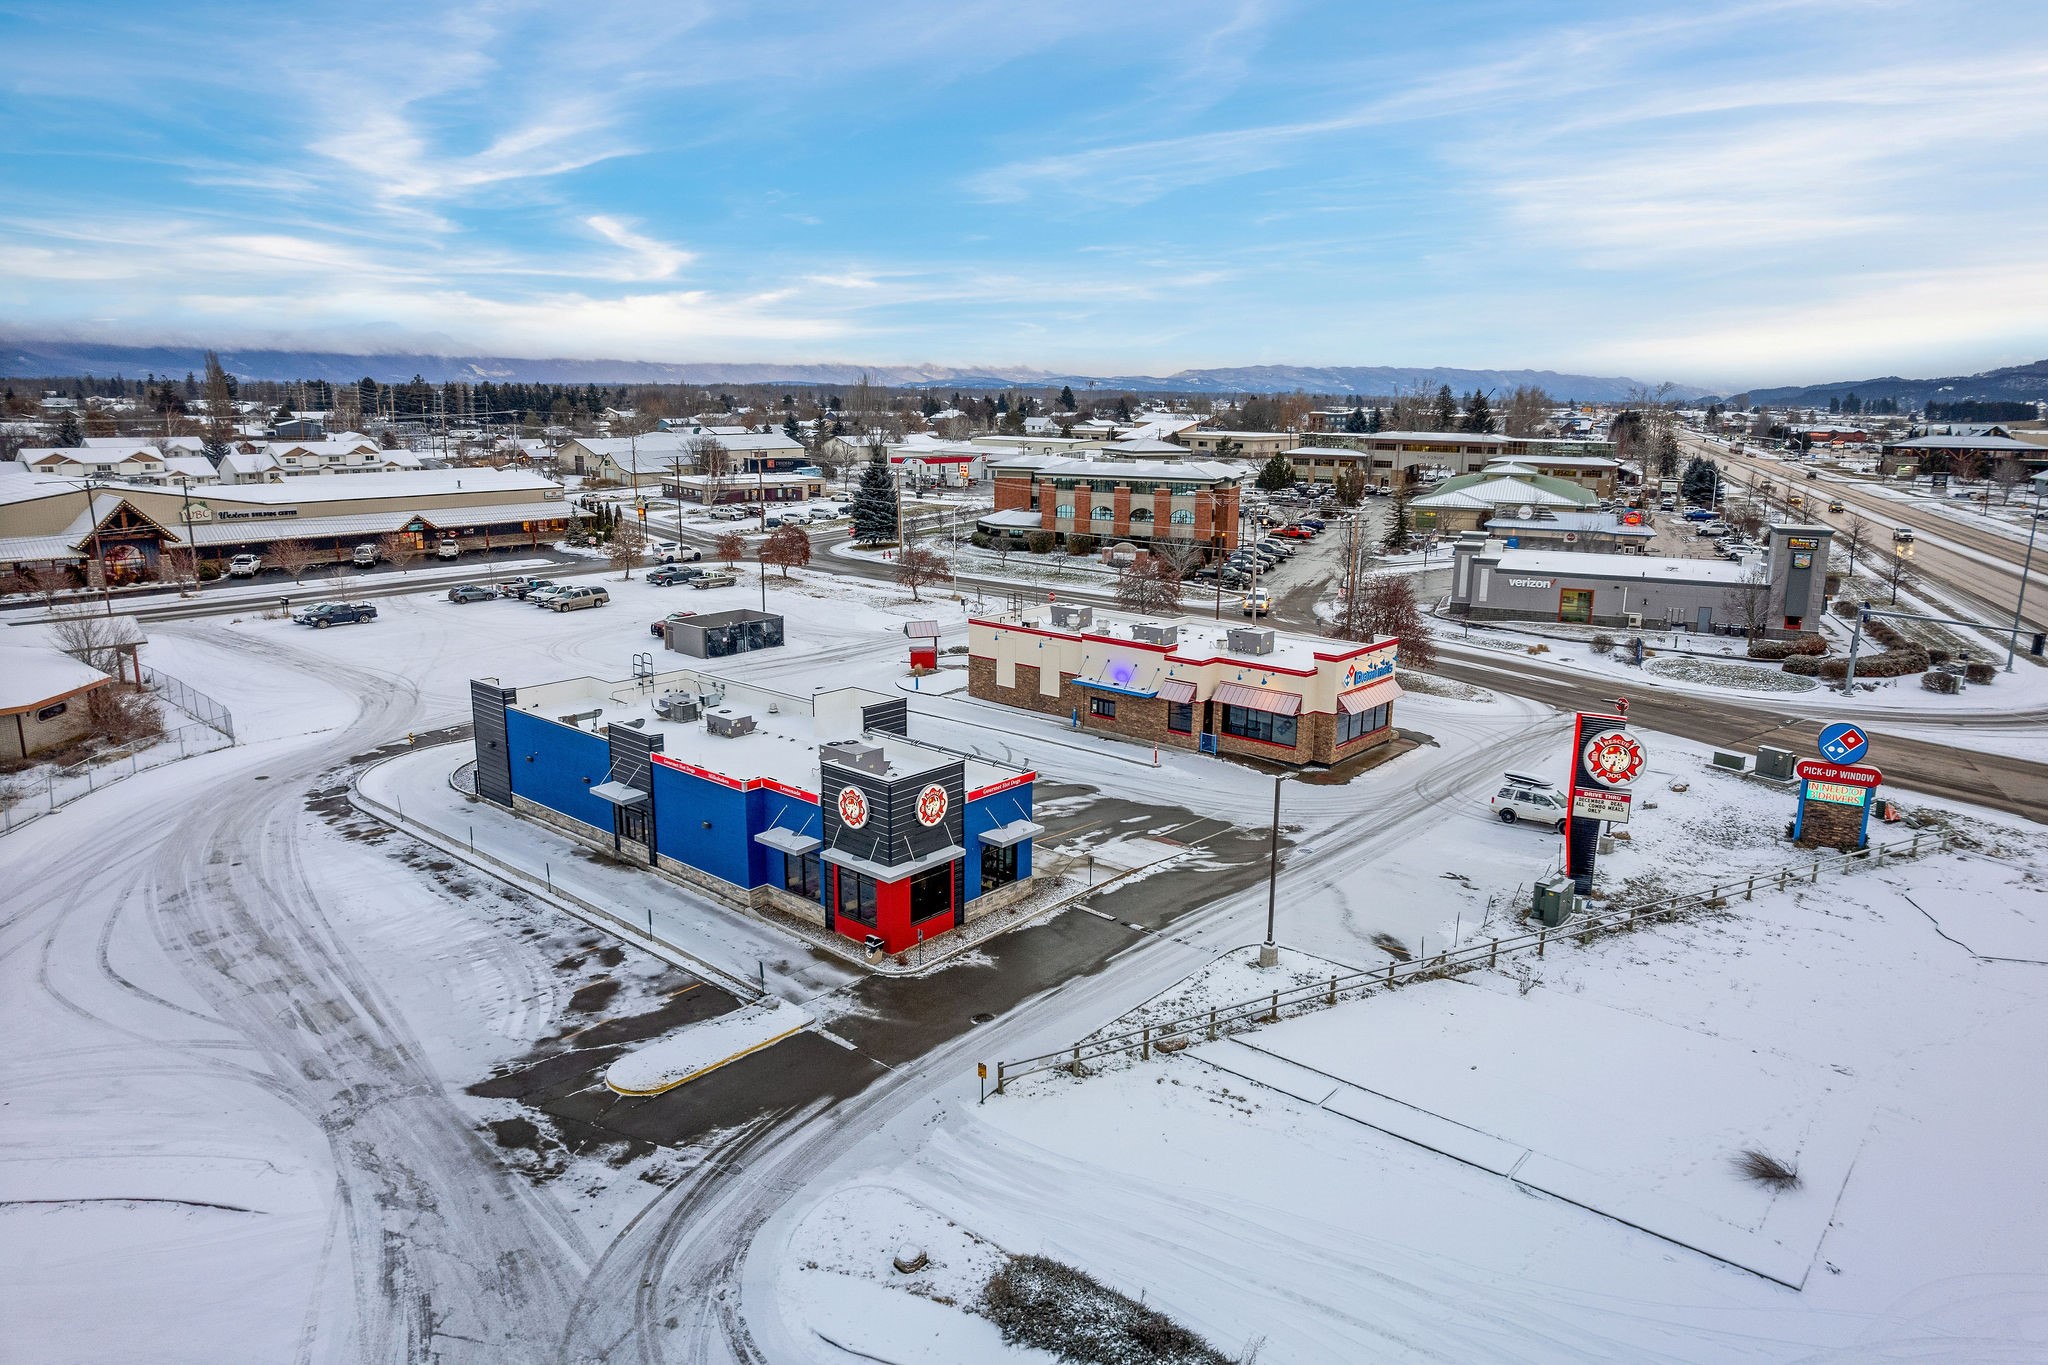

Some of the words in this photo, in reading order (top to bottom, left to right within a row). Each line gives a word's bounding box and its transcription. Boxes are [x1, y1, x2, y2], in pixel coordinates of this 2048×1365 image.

[1508, 577, 1551, 589] verizon
[1604, 739, 1630, 748] RESCUE
[1803, 766, 1837, 777] PICK-UP
[1840, 771, 1875, 782] WINDOW
[983, 785, 1002, 794] Gourmet
[1808, 782, 1819, 791] IN
[1822, 784, 1849, 795] NEED
[1851, 788, 1863, 796] OF
[1818, 792, 1859, 804] DRIVERS
